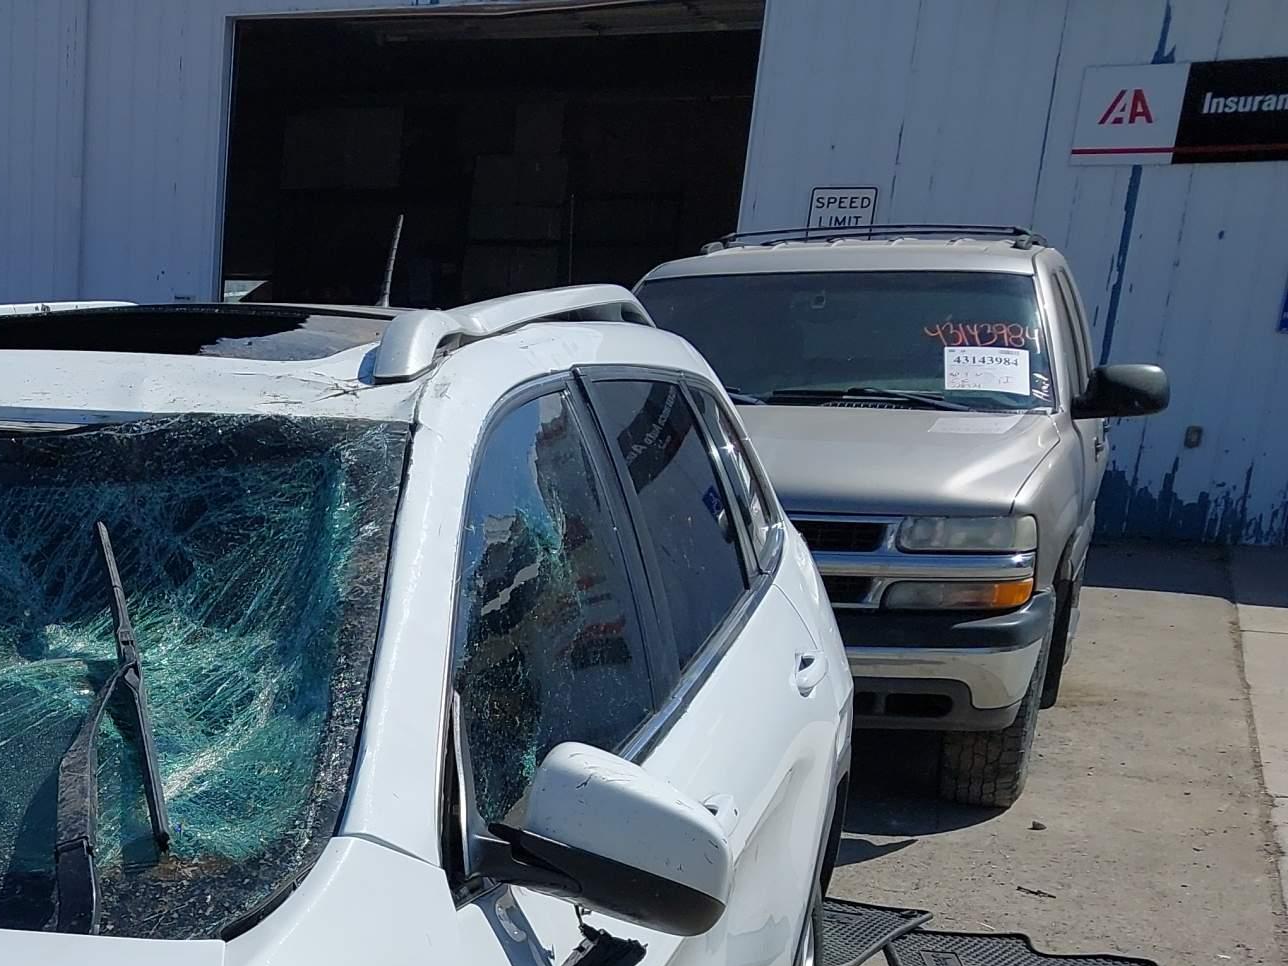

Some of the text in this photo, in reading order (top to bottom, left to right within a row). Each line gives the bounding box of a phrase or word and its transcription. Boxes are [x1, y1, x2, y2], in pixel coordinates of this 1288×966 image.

[815, 196, 871, 209] SPEED
[819, 215, 862, 227] LIMIT
[953, 355, 1019, 367] 43143984
